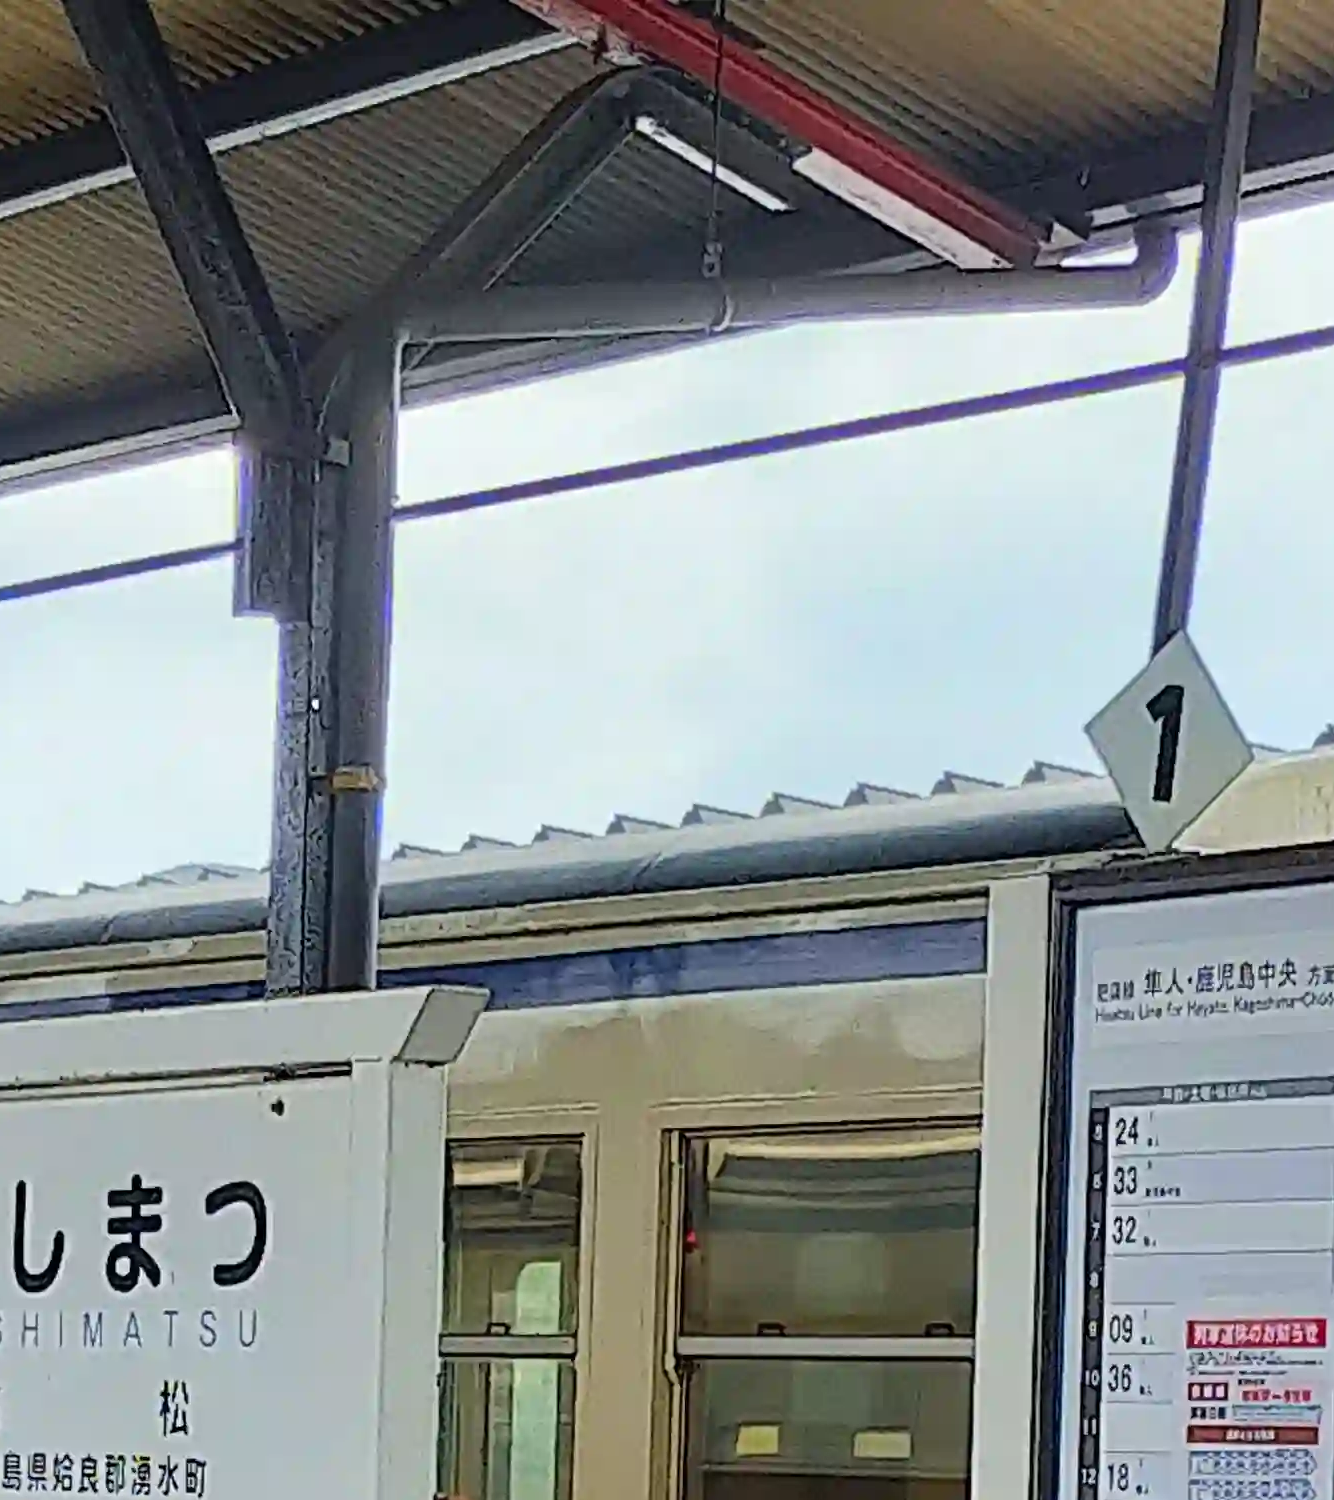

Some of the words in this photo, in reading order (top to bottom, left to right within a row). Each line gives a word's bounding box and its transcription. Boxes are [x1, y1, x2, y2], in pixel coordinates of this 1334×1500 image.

[1146, 685, 1184, 803] 1
[1115, 1117, 1139, 1147] 24
[1114, 1166, 1138, 1195] 33
[1112, 1216, 1137, 1245] 32
[1109, 1314, 1134, 1344] 09
[1108, 1364, 1132, 1393] 36
[1107, 1463, 1130, 1491] 18
